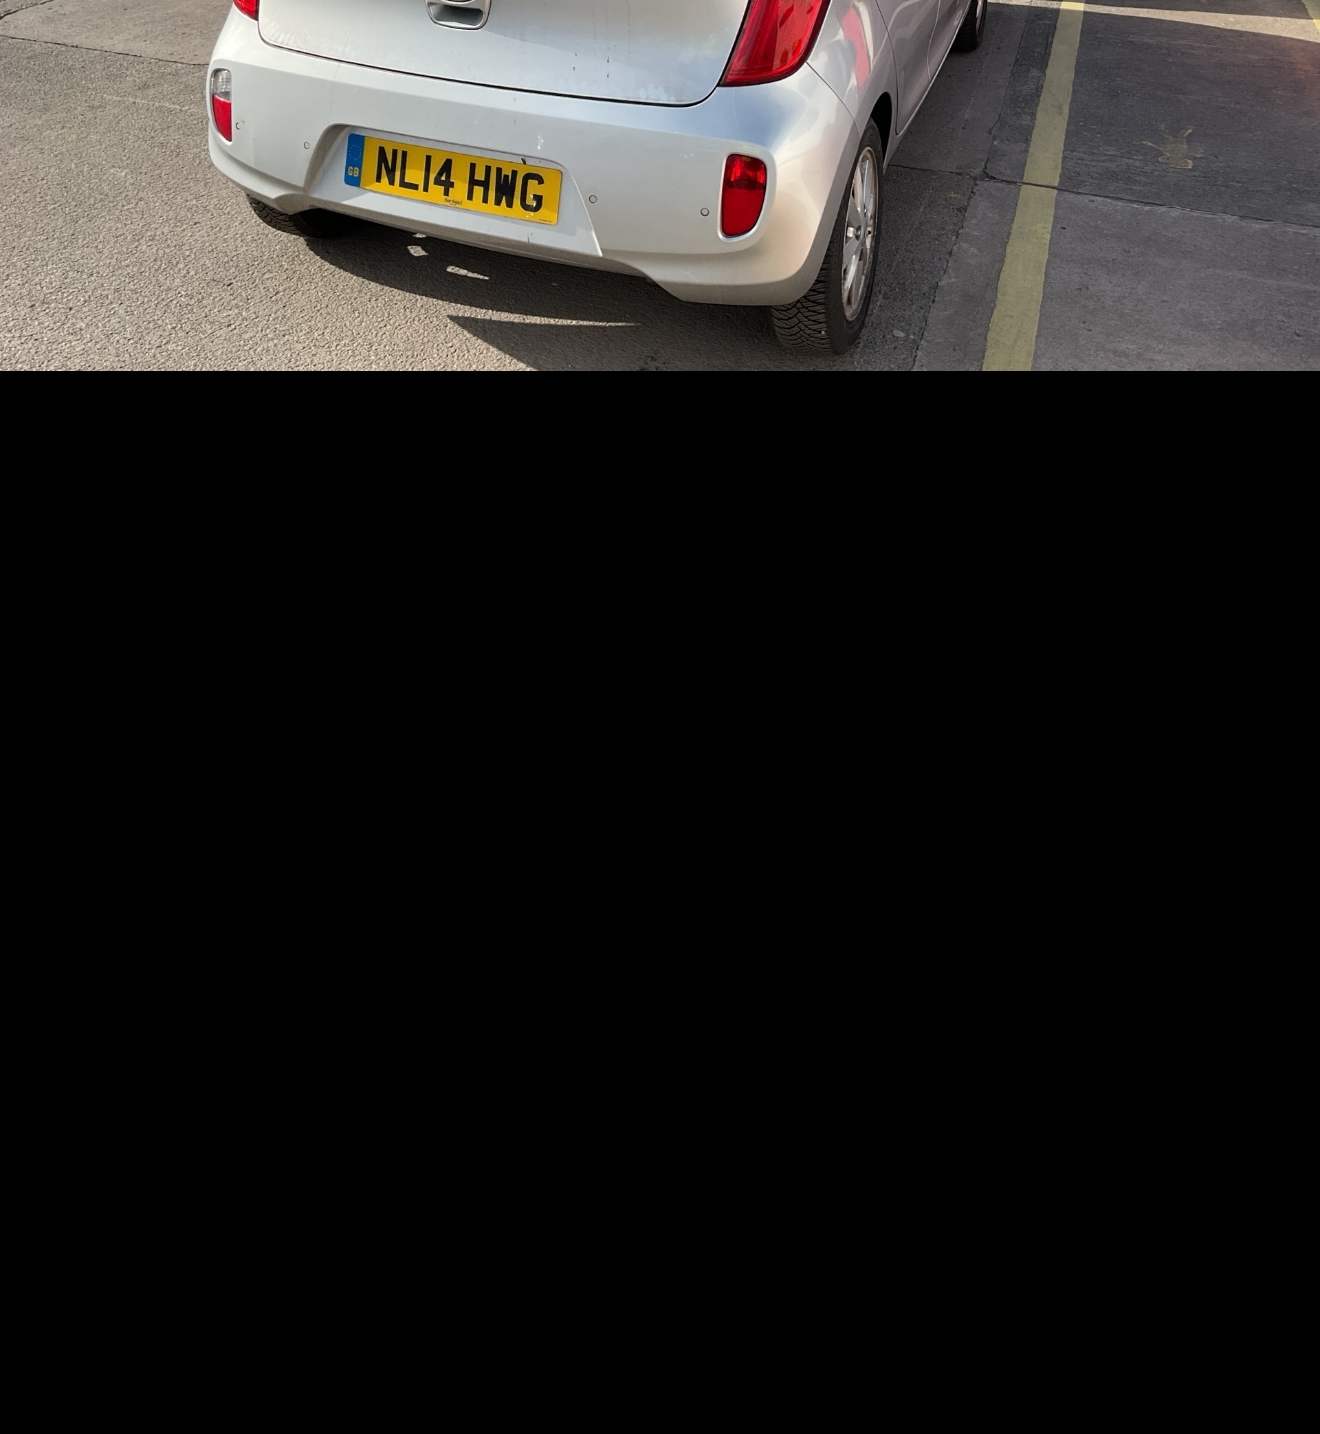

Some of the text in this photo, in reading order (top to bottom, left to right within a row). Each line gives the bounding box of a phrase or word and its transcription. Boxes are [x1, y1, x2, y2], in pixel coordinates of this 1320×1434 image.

[347, 166, 360, 177] GB
[375, 145, 545, 213] NL14 HWG
